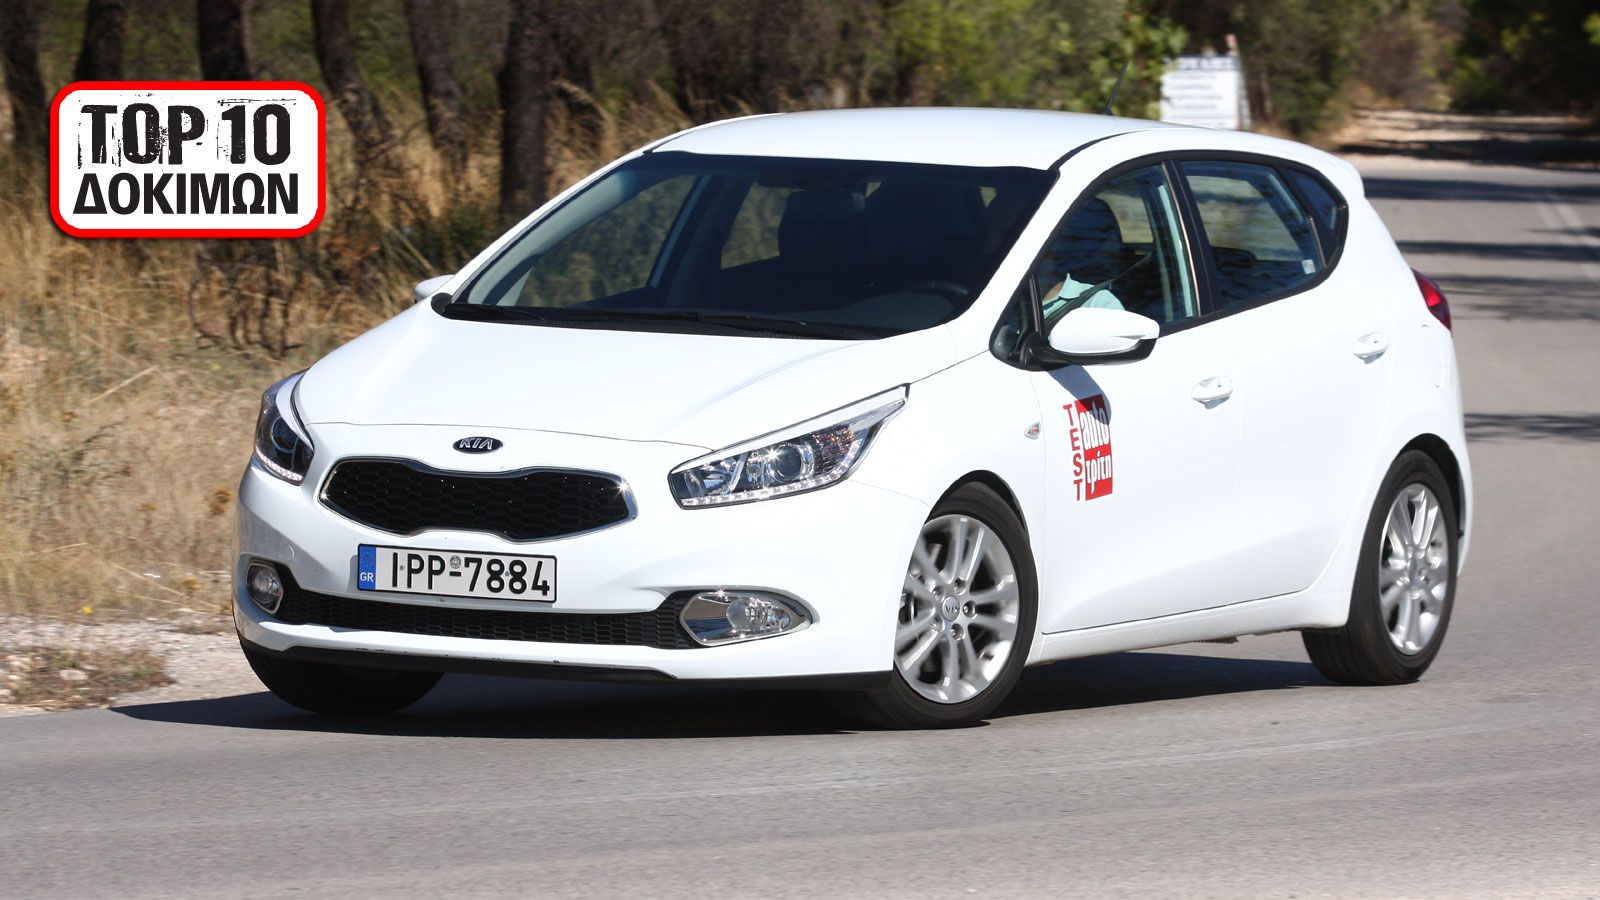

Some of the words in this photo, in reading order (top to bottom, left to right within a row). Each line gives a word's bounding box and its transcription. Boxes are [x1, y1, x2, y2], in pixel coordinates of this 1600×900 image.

[1079, 401, 1110, 450] auto
[458, 437, 493, 450] KIA
[1063, 404, 1083, 501] TEST
[360, 572, 374, 583] GR
